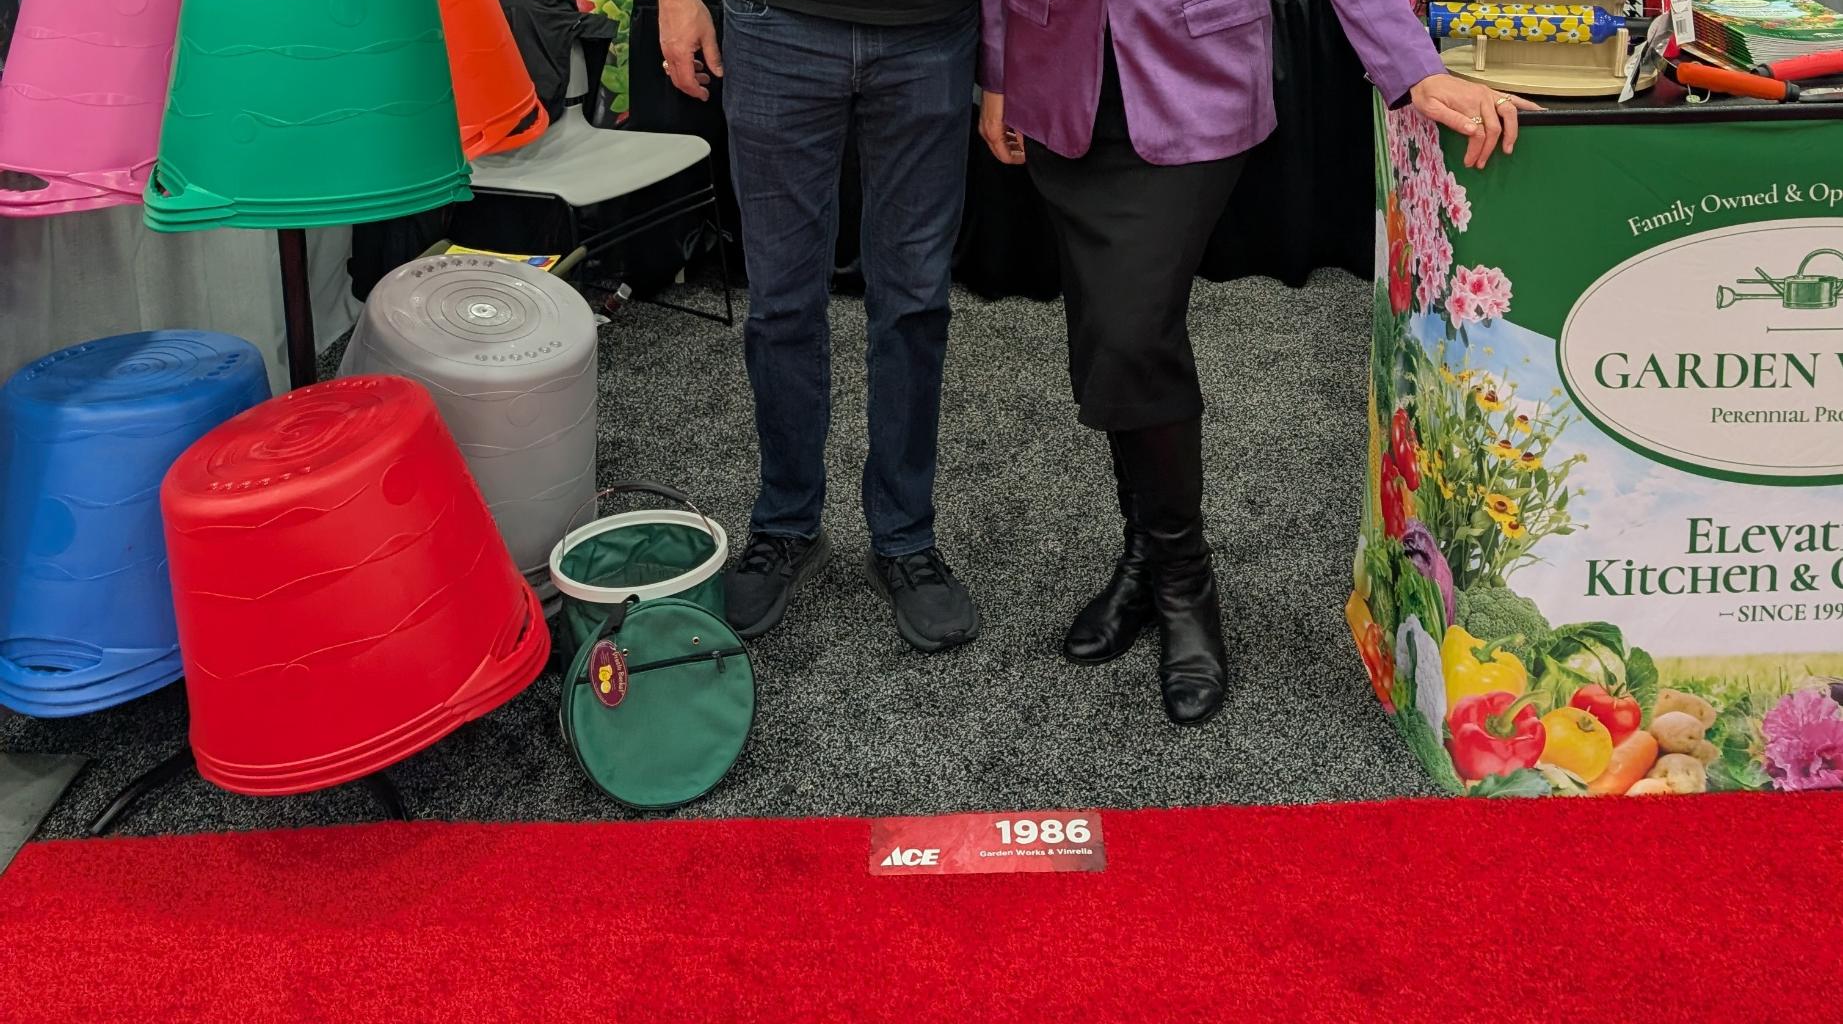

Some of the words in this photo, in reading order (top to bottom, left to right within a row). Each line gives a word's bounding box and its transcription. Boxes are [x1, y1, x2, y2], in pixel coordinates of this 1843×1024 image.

[1627, 200, 1696, 237] Family
[1700, 183, 1779, 213] Owned
[1784, 183, 1804, 203] &
[1594, 352, 1822, 389] GARDEN
[1685, 517, 1843, 554] Elevat
[1790, 563, 1820, 592] &
[1737, 604, 1807, 623] SINCE
[995, 819, 1092, 844] 1986
[880, 846, 941, 866] ACE
[979, 849, 1014, 857] Garden
[1016, 848, 1046, 856] Works
[1056, 847, 1093, 855] Vinrella
